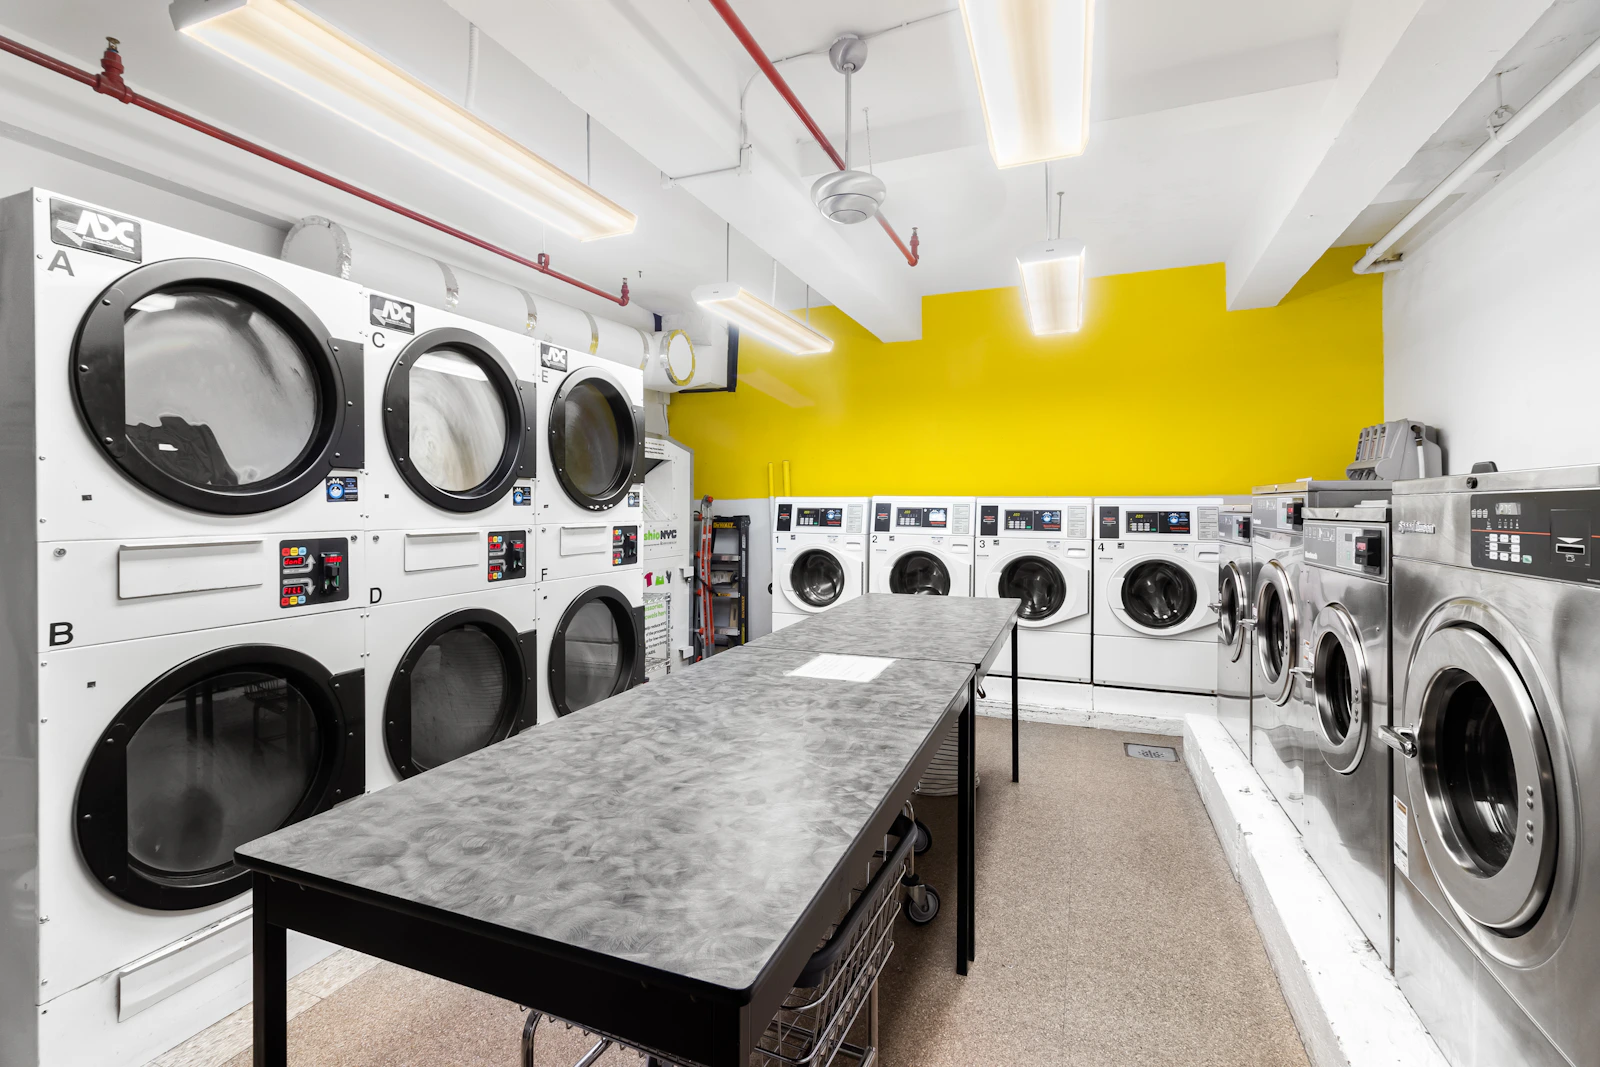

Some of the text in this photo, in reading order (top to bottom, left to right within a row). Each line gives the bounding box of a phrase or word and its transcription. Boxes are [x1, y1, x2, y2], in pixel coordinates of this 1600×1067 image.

[76, 209, 134, 247] ADC
[47, 249, 75, 277] A
[382, 300, 411, 324] ADC
[372, 332, 385, 348] C
[547, 347, 566, 364] ADC
[542, 370, 549, 383] E
[872, 535, 878, 543] 2
[979, 540, 986, 548] 3
[1098, 543, 1105, 551] 4
[541, 568, 548, 582] F
[370, 587, 382, 605] D
[49, 622, 74, 647] B
